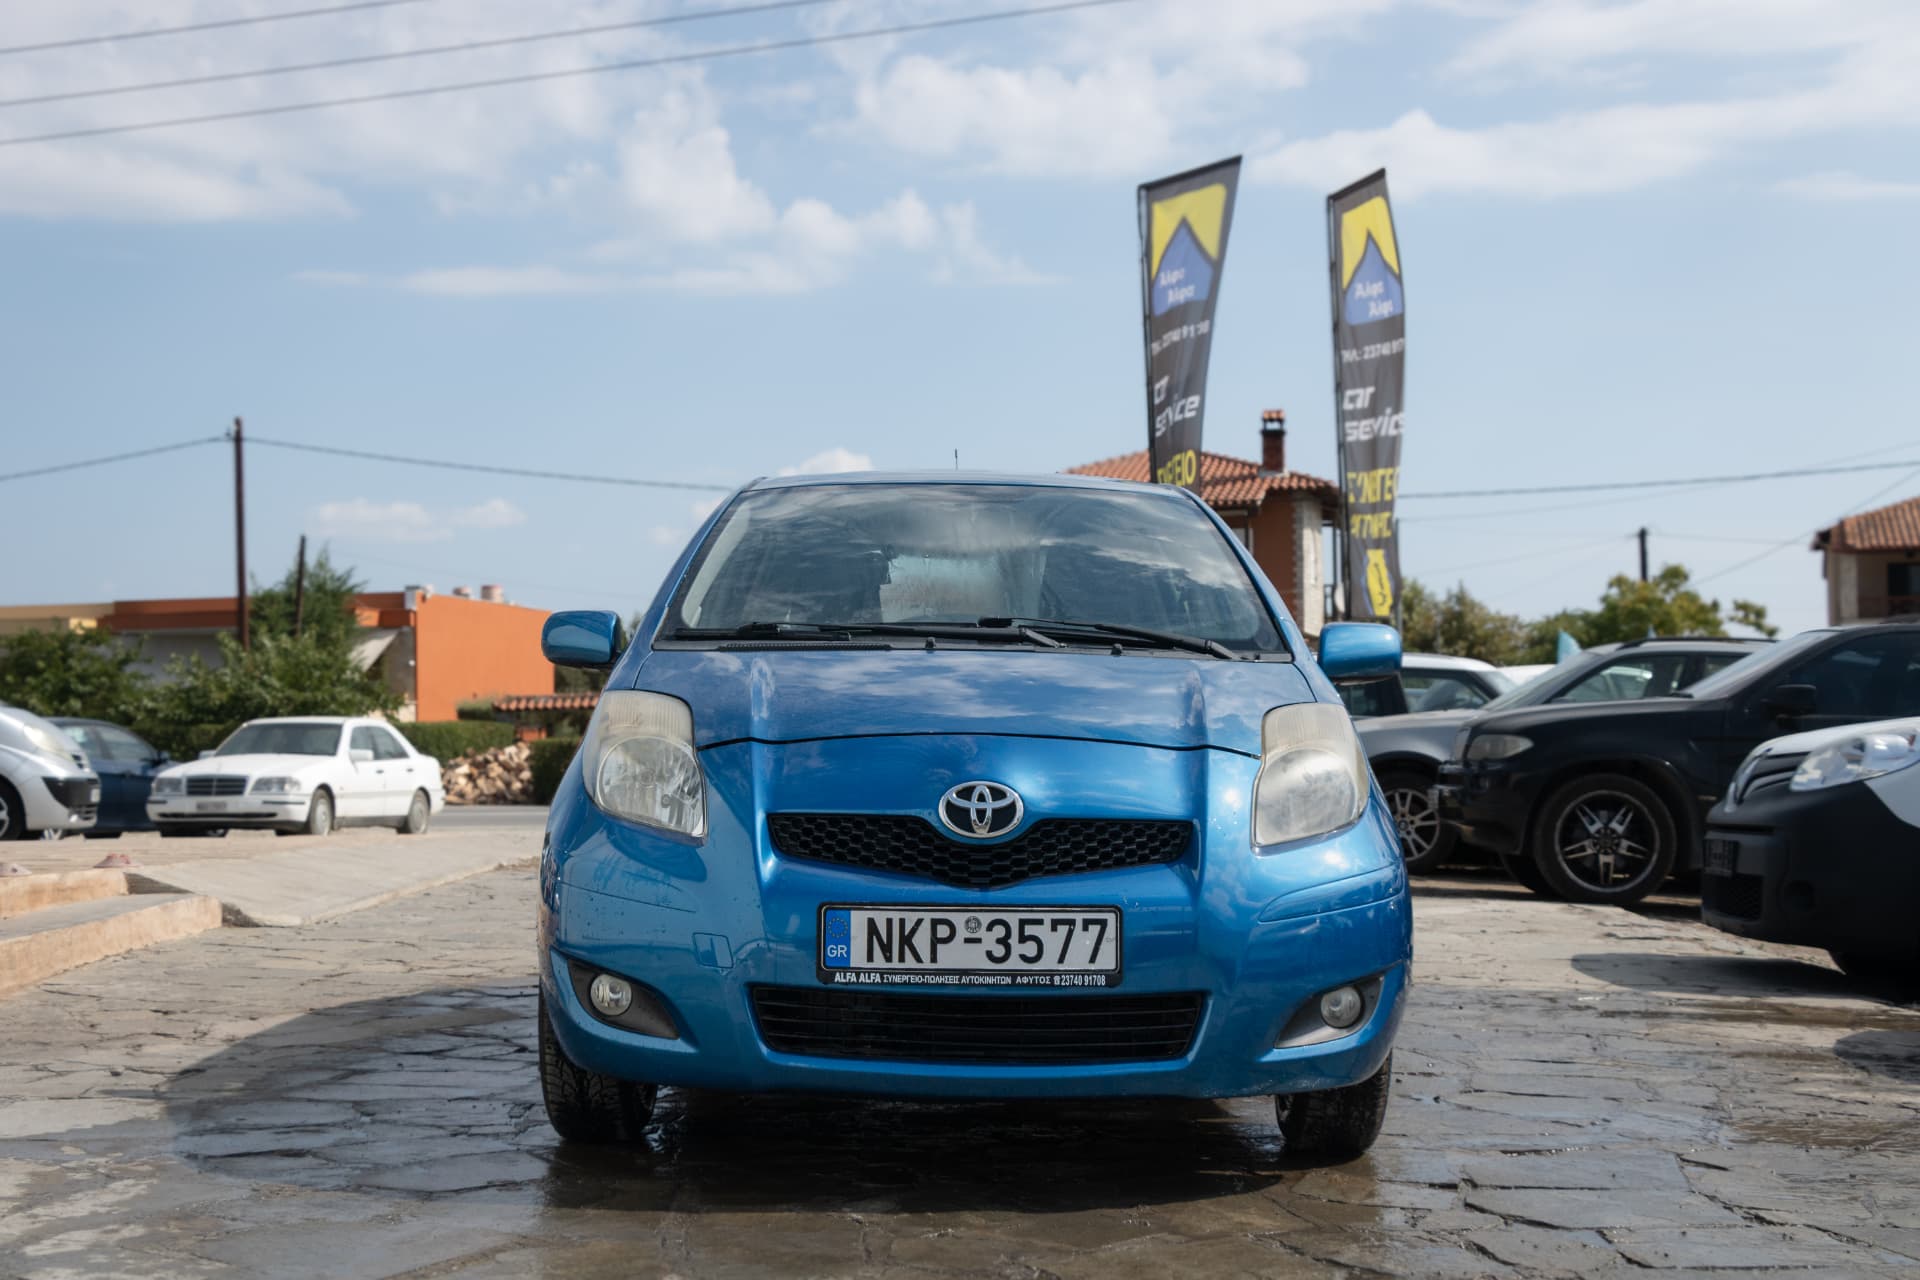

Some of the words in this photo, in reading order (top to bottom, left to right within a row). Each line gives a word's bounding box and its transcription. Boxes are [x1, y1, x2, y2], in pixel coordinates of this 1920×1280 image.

[866, 917, 1108, 964] NKP-3577
[827, 944, 848, 958] GR
[834, 971, 857, 983] ALFA
[859, 972, 881, 984] ALFA
[1016, 975, 1051, 985] ΑΦΥΤΟΣ
